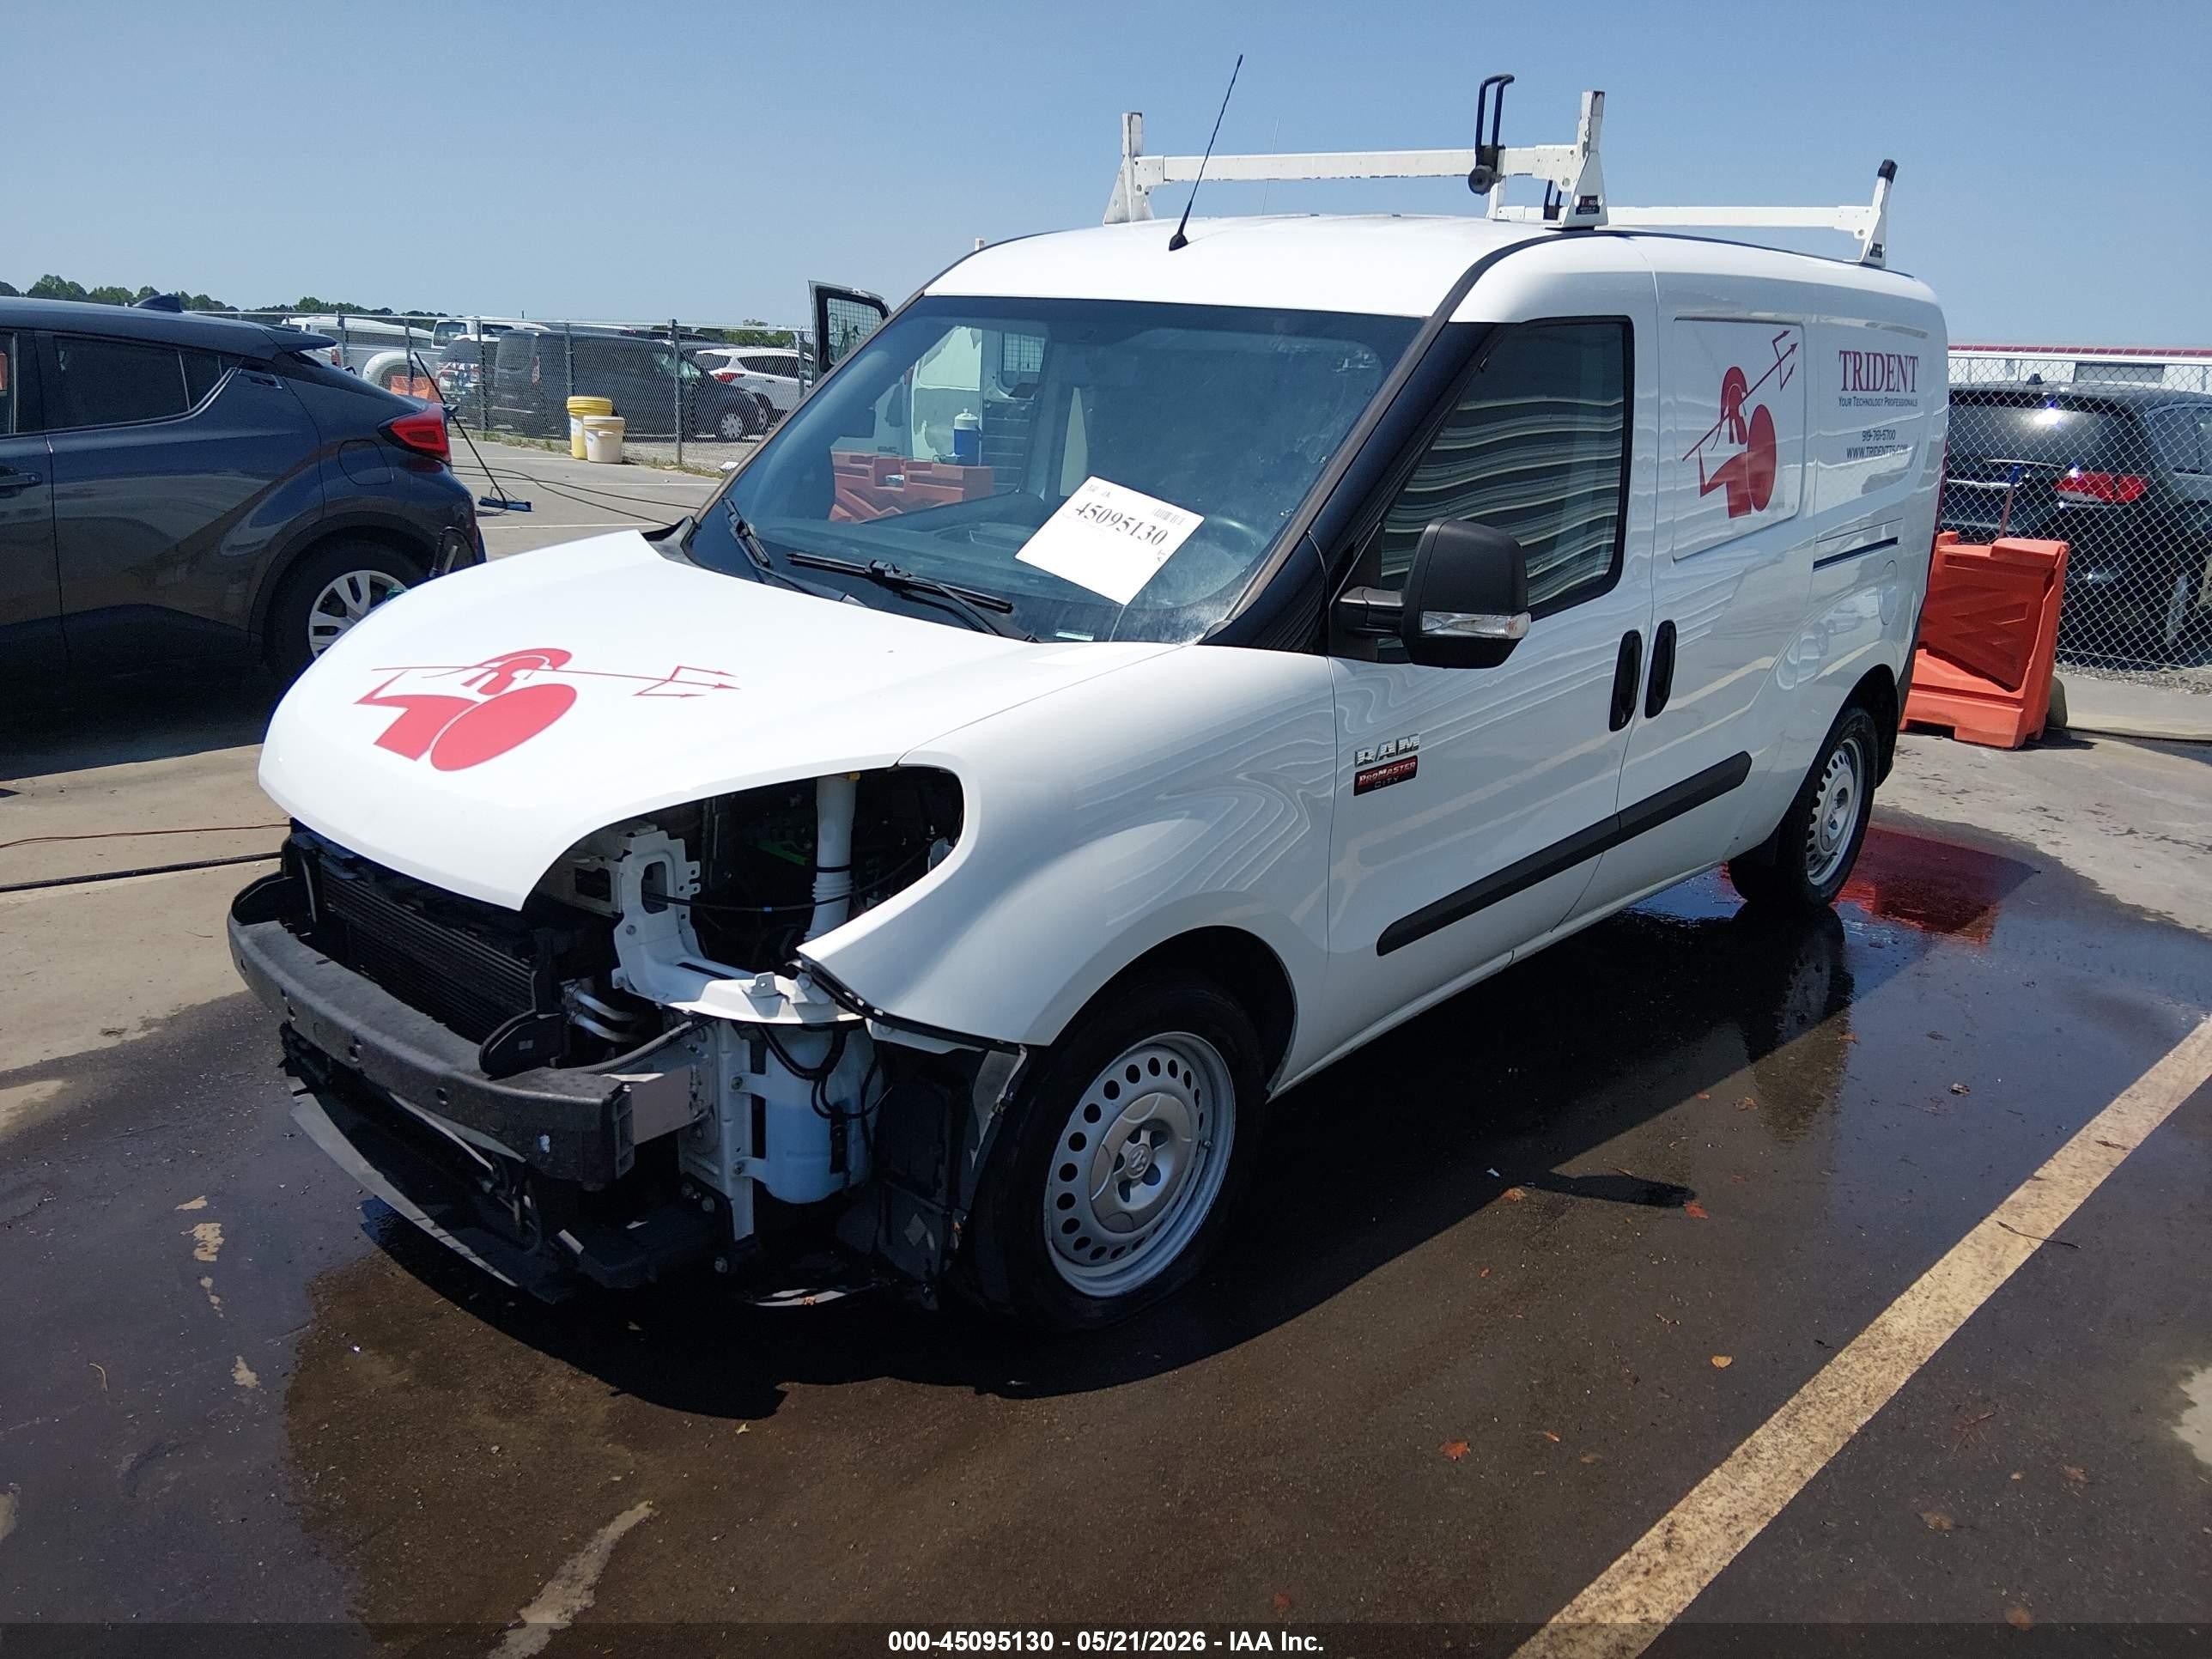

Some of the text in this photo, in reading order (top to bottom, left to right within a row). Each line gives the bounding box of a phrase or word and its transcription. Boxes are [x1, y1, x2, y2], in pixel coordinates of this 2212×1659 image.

[1838, 350, 1919, 393] TRIDENT
[1075, 501, 1169, 545] 45095130
[1354, 733, 1420, 768] RAM
[1374, 775, 1400, 789] CITY
